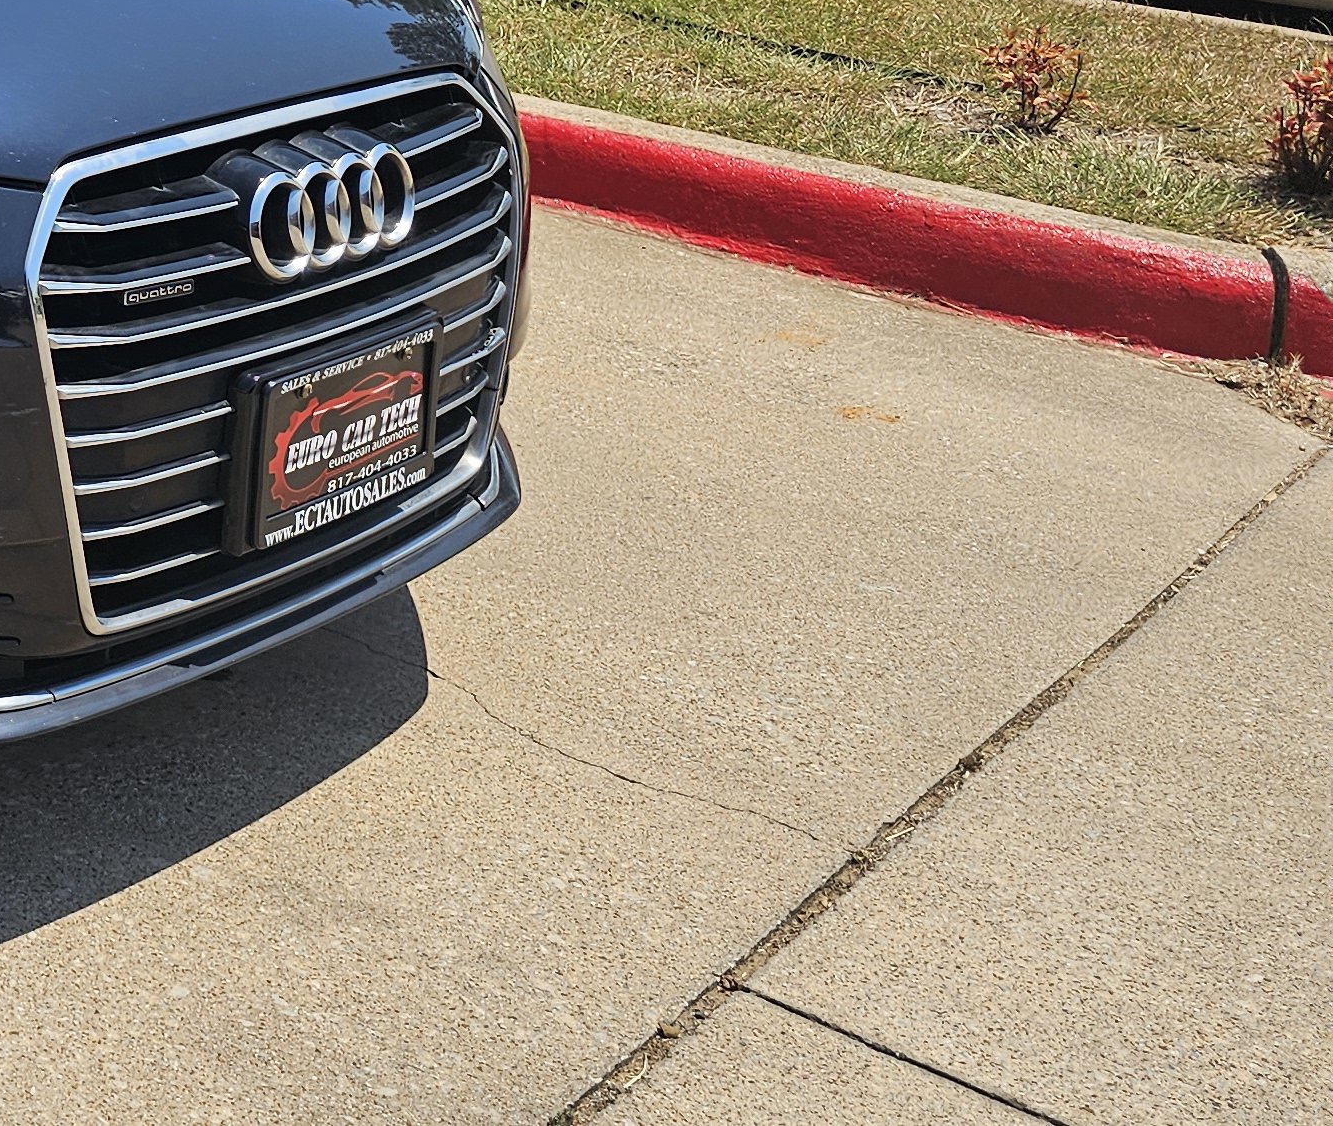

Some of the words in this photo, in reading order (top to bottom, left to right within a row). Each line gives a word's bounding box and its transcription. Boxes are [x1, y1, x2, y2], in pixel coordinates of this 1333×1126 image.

[128, 283, 192, 303] quattro
[281, 373, 312, 395] SALES
[322, 355, 365, 379] SERVICE
[373, 329, 434, 361] 817-404-4033
[284, 429, 338, 475] EURO
[341, 415, 377, 453] CAR
[379, 393, 423, 437] TECH
[328, 444, 371, 469] european
[372, 423, 419, 450] automotive
[327, 444, 417, 493] 817-404-4033
[264, 466, 426, 548] www.ECTAUTOSALES.com
